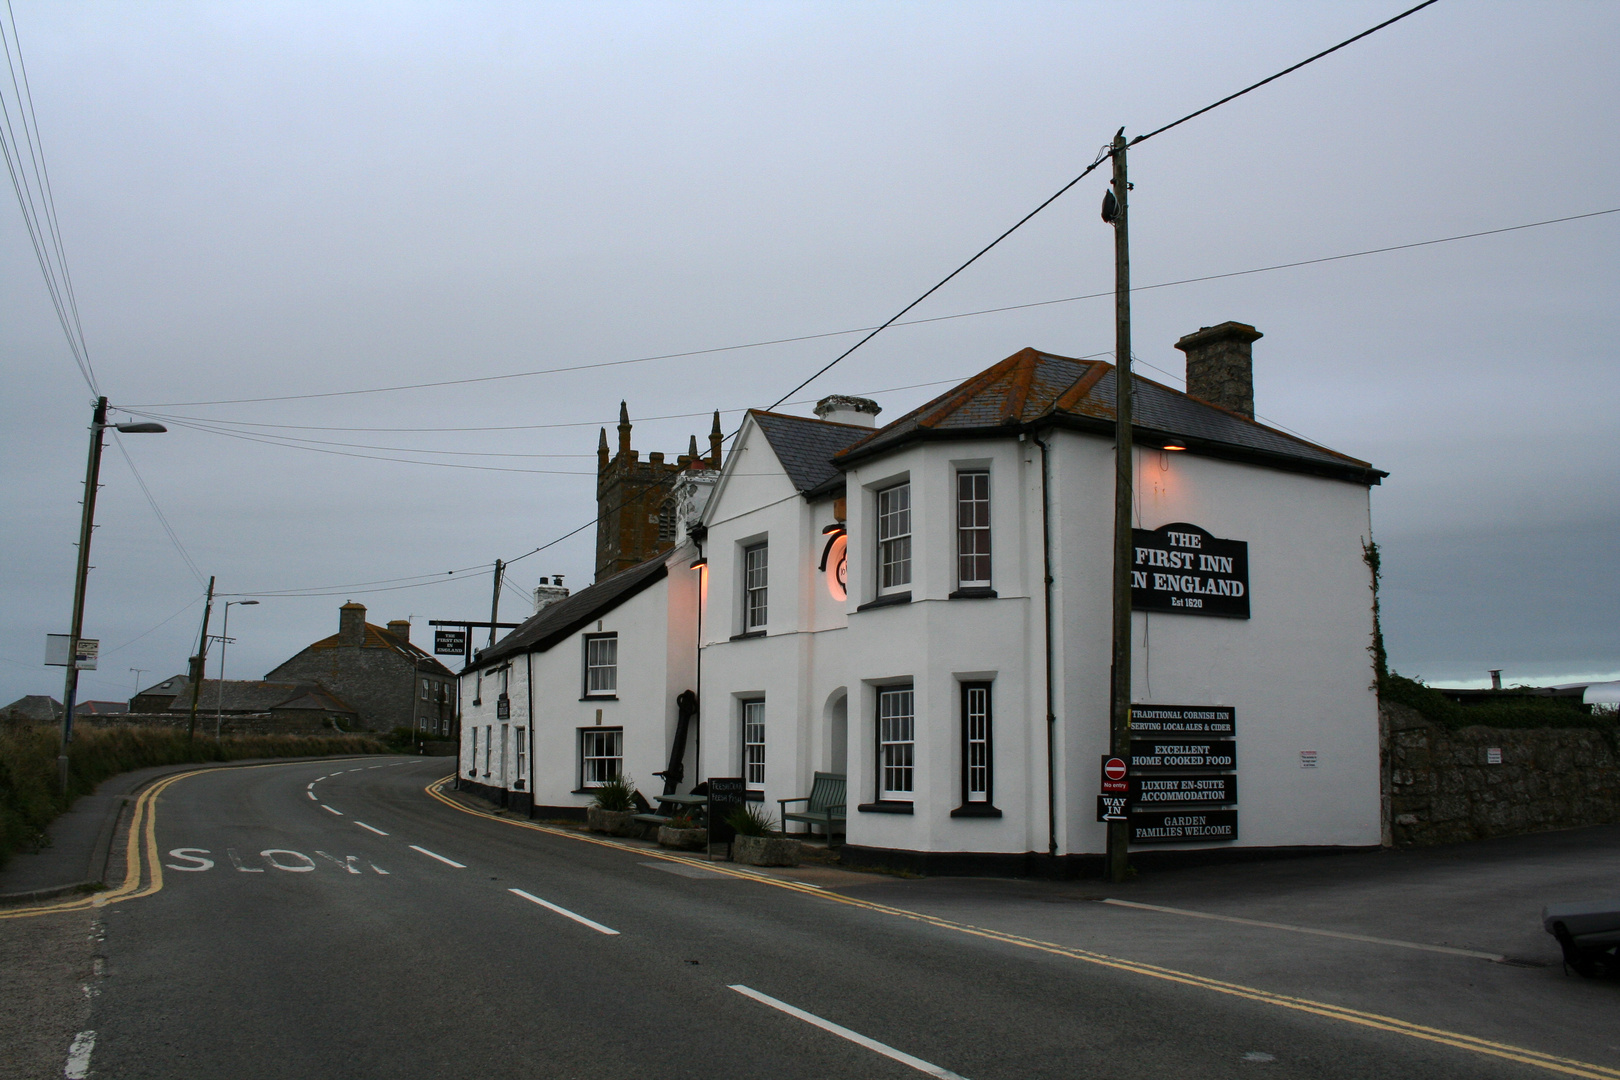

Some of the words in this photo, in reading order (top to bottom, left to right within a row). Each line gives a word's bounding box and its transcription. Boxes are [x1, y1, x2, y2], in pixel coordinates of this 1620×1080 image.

[1167, 531, 1202, 549] THE
[1135, 547, 1194, 570] FIRST
[1199, 554, 1233, 574] INN
[1153, 573, 1245, 597] ENGLAND
[1171, 596, 1184, 607] Est
[1185, 598, 1203, 608] 1620
[1132, 710, 1182, 719] TRADITIONAL
[1183, 711, 1215, 720] CORNISH
[1216, 712, 1229, 720] INN
[1130, 722, 1161, 731] SERVING
[1163, 723, 1185, 731] LOCAL
[1185, 723, 1203, 731] ALES
[1210, 723, 1231, 732] CIDER
[1154, 745, 1210, 755] EXCELLENT
[1132, 756, 1162, 766] HOME
[1163, 756, 1204, 766] COOKED
[1205, 756, 1232, 766] FOOD
[1141, 781, 1179, 790] LUXURY
[1181, 780, 1225, 789] EN-SUITE
[1141, 791, 1225, 801] ACCOMMODATION
[1103, 797, 1127, 807] WAY
[1108, 806, 1121, 815] IN
[1164, 816, 1206, 826] GARDEN
[1136, 827, 1182, 838] FAMILIES
[1184, 825, 1232, 836] WELCOME
